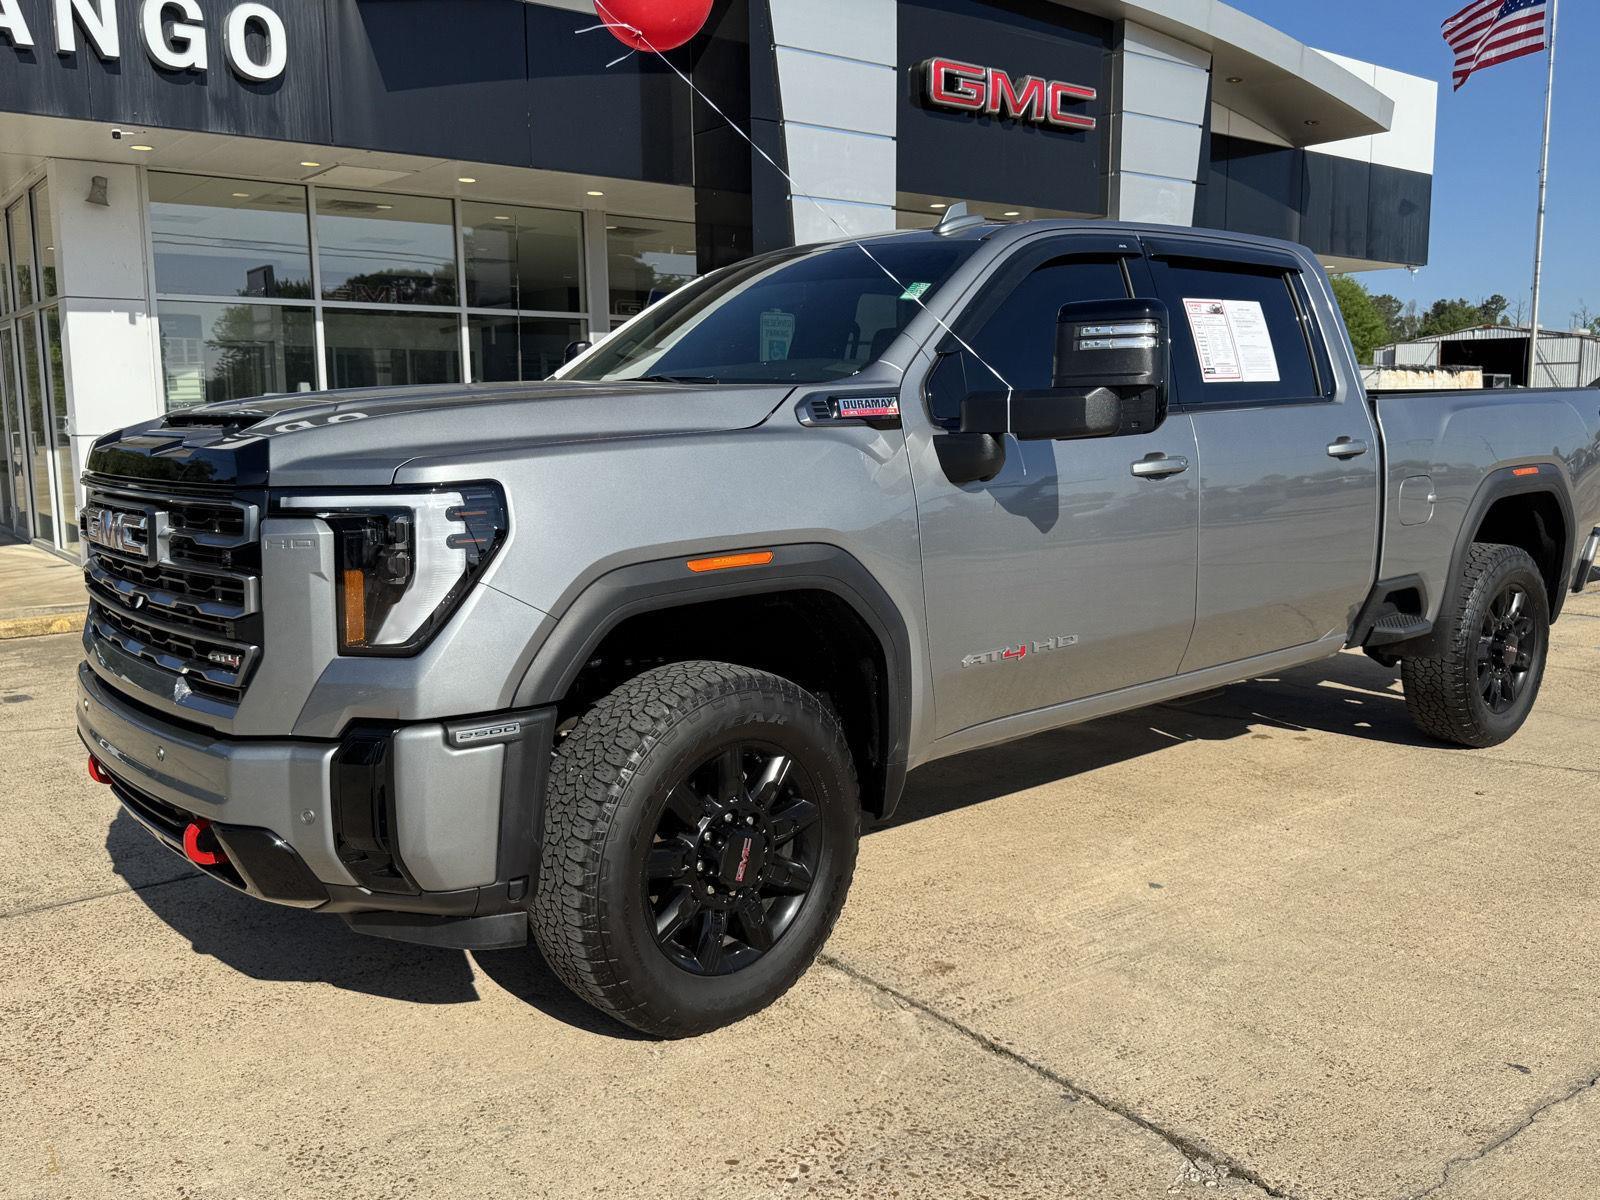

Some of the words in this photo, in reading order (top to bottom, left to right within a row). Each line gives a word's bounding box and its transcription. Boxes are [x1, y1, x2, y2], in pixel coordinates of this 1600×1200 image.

[925, 57, 1097, 131] GMC
[843, 398, 894, 410] DURAMAX
[88, 508, 148, 556] GMC
[265, 539, 316, 550] HD
[961, 644, 1026, 668] AT4
[1032, 633, 1079, 653] HD
[456, 722, 520, 742] 2500
